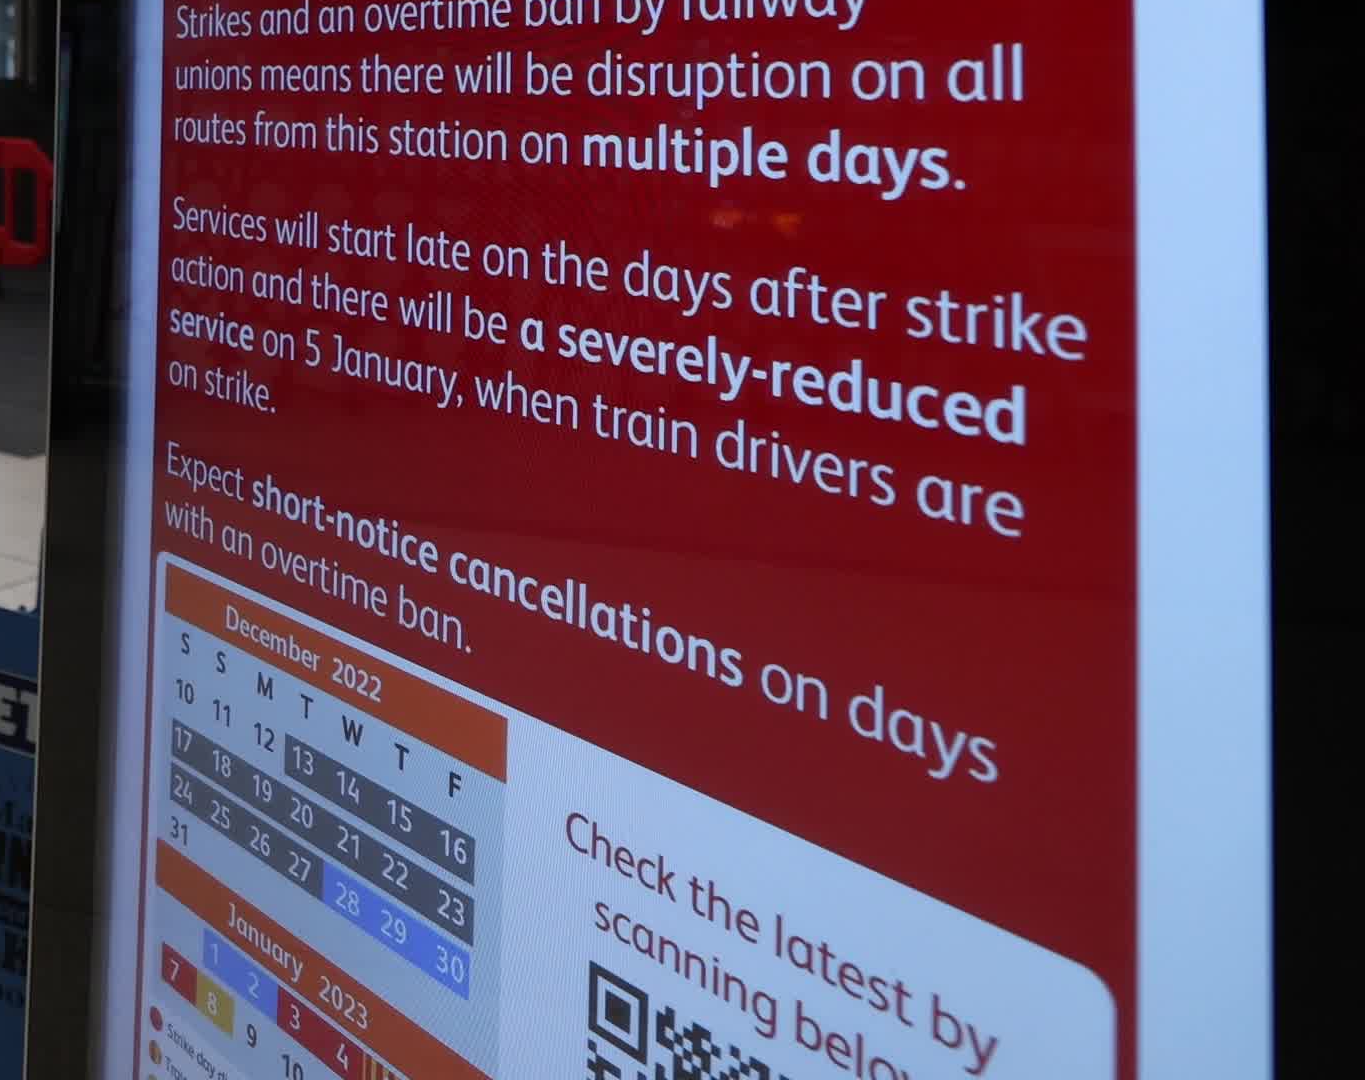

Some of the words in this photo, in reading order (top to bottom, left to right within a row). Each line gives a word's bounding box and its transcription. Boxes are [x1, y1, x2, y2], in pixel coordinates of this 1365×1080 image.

[176, 3, 252, 39] Strikes
[318, 5, 354, 34] an
[176, 65, 252, 91] unions
[261, 64, 352, 93] means
[360, 53, 444, 94] there
[454, 51, 512, 94] will
[526, 50, 573, 96] be
[587, 49, 831, 110] disruption
[851, 59, 925, 101] on
[947, 42, 1023, 102] all
[175, 113, 246, 145] routes
[253, 110, 317, 149] from
[325, 113, 379, 154] this
[389, 119, 507, 161] station
[520, 131, 568, 165] on
[583, 123, 789, 189] multiple
[807, 128, 966, 201] days.
[171, 255, 244, 293] action
[252, 268, 302, 305] and
[311, 271, 388, 321] there
[399, 290, 452, 334] will
[464, 295, 508, 344] be
[520, 317, 545, 353] a
[558, 324, 1025, 445] severely-reduced
[173, 196, 267, 242] Services
[275, 211, 318, 249] will
[328, 219, 397, 261] start
[407, 222, 471, 272] late
[482, 244, 529, 280] on
[541, 239, 609, 291] the
[623, 249, 733, 317] days
[750, 266, 887, 330] after
[906, 290, 1087, 361] strike
[169, 361, 197, 390] on
[205, 367, 276, 413] strike.
[170, 308, 254, 351] service
[262, 329, 295, 361] on
[305, 328, 321, 367] 5
[331, 334, 463, 409] January,
[474, 370, 578, 430] when
[592, 394, 698, 459] train
[715, 419, 896, 506] drivers
[916, 475, 1024, 537] are
[166, 503, 214, 544] with
[221, 525, 253, 561] an
[261, 541, 388, 617] overtime
[398, 583, 474, 654] ban.
[167, 441, 244, 501] Expect
[252, 474, 439, 573] short-notice
[449, 551, 744, 687] cancellations
[760, 663, 828, 720] on
[848, 684, 998, 782] days
[224, 605, 320, 672] December
[331, 657, 382, 703] 2022
[176, 679, 195, 704] 10
[213, 699, 231, 727] 11
[254, 722, 275, 752] 12
[293, 745, 315, 776] 13
[337, 770, 361, 805] 14
[387, 799, 413, 832] 15
[440, 829, 467, 865] 16
[181, 632, 191, 655] S
[216, 651, 227, 673] S
[257, 672, 274, 701] M
[300, 694, 314, 720] T
[341, 715, 364, 747] W
[394, 742, 409, 771] T
[449, 771, 461, 798] F
[170, 815, 188, 847] 31
[173, 775, 192, 805] 24
[210, 802, 230, 830] 25
[249, 825, 271, 857] 26
[288, 851, 311, 883] 27
[335, 882, 360, 916] 28
[380, 909, 407, 945] 29
[437, 944, 464, 983] 30
[174, 727, 192, 752] 17
[213, 750, 231, 778] 18
[253, 774, 272, 802] 19
[290, 797, 313, 829] 20
[337, 825, 360, 859] 21
[381, 853, 409, 890] 22
[437, 888, 465, 927] 23
[170, 958, 180, 982] 7
[206, 991, 218, 1017] 8
[246, 1023, 258, 1048] 9
[282, 1053, 303, 1080] 10
[209, 943, 219, 965] 1
[248, 971, 260, 999] 2
[289, 1004, 301, 1030] 3
[336, 1042, 350, 1070] 4
[227, 902, 304, 982] January
[318, 975, 369, 1031] 2023
[565, 811, 677, 903] Check
[687, 875, 762, 945] the
[774, 914, 914, 1028] latest
[931, 993, 999, 1077] by
[594, 900, 778, 1039] scanning
[795, 999, 909, 1080] belo
[167, 1023, 195, 1059] Strike
[197, 1053, 215, 1079] day
